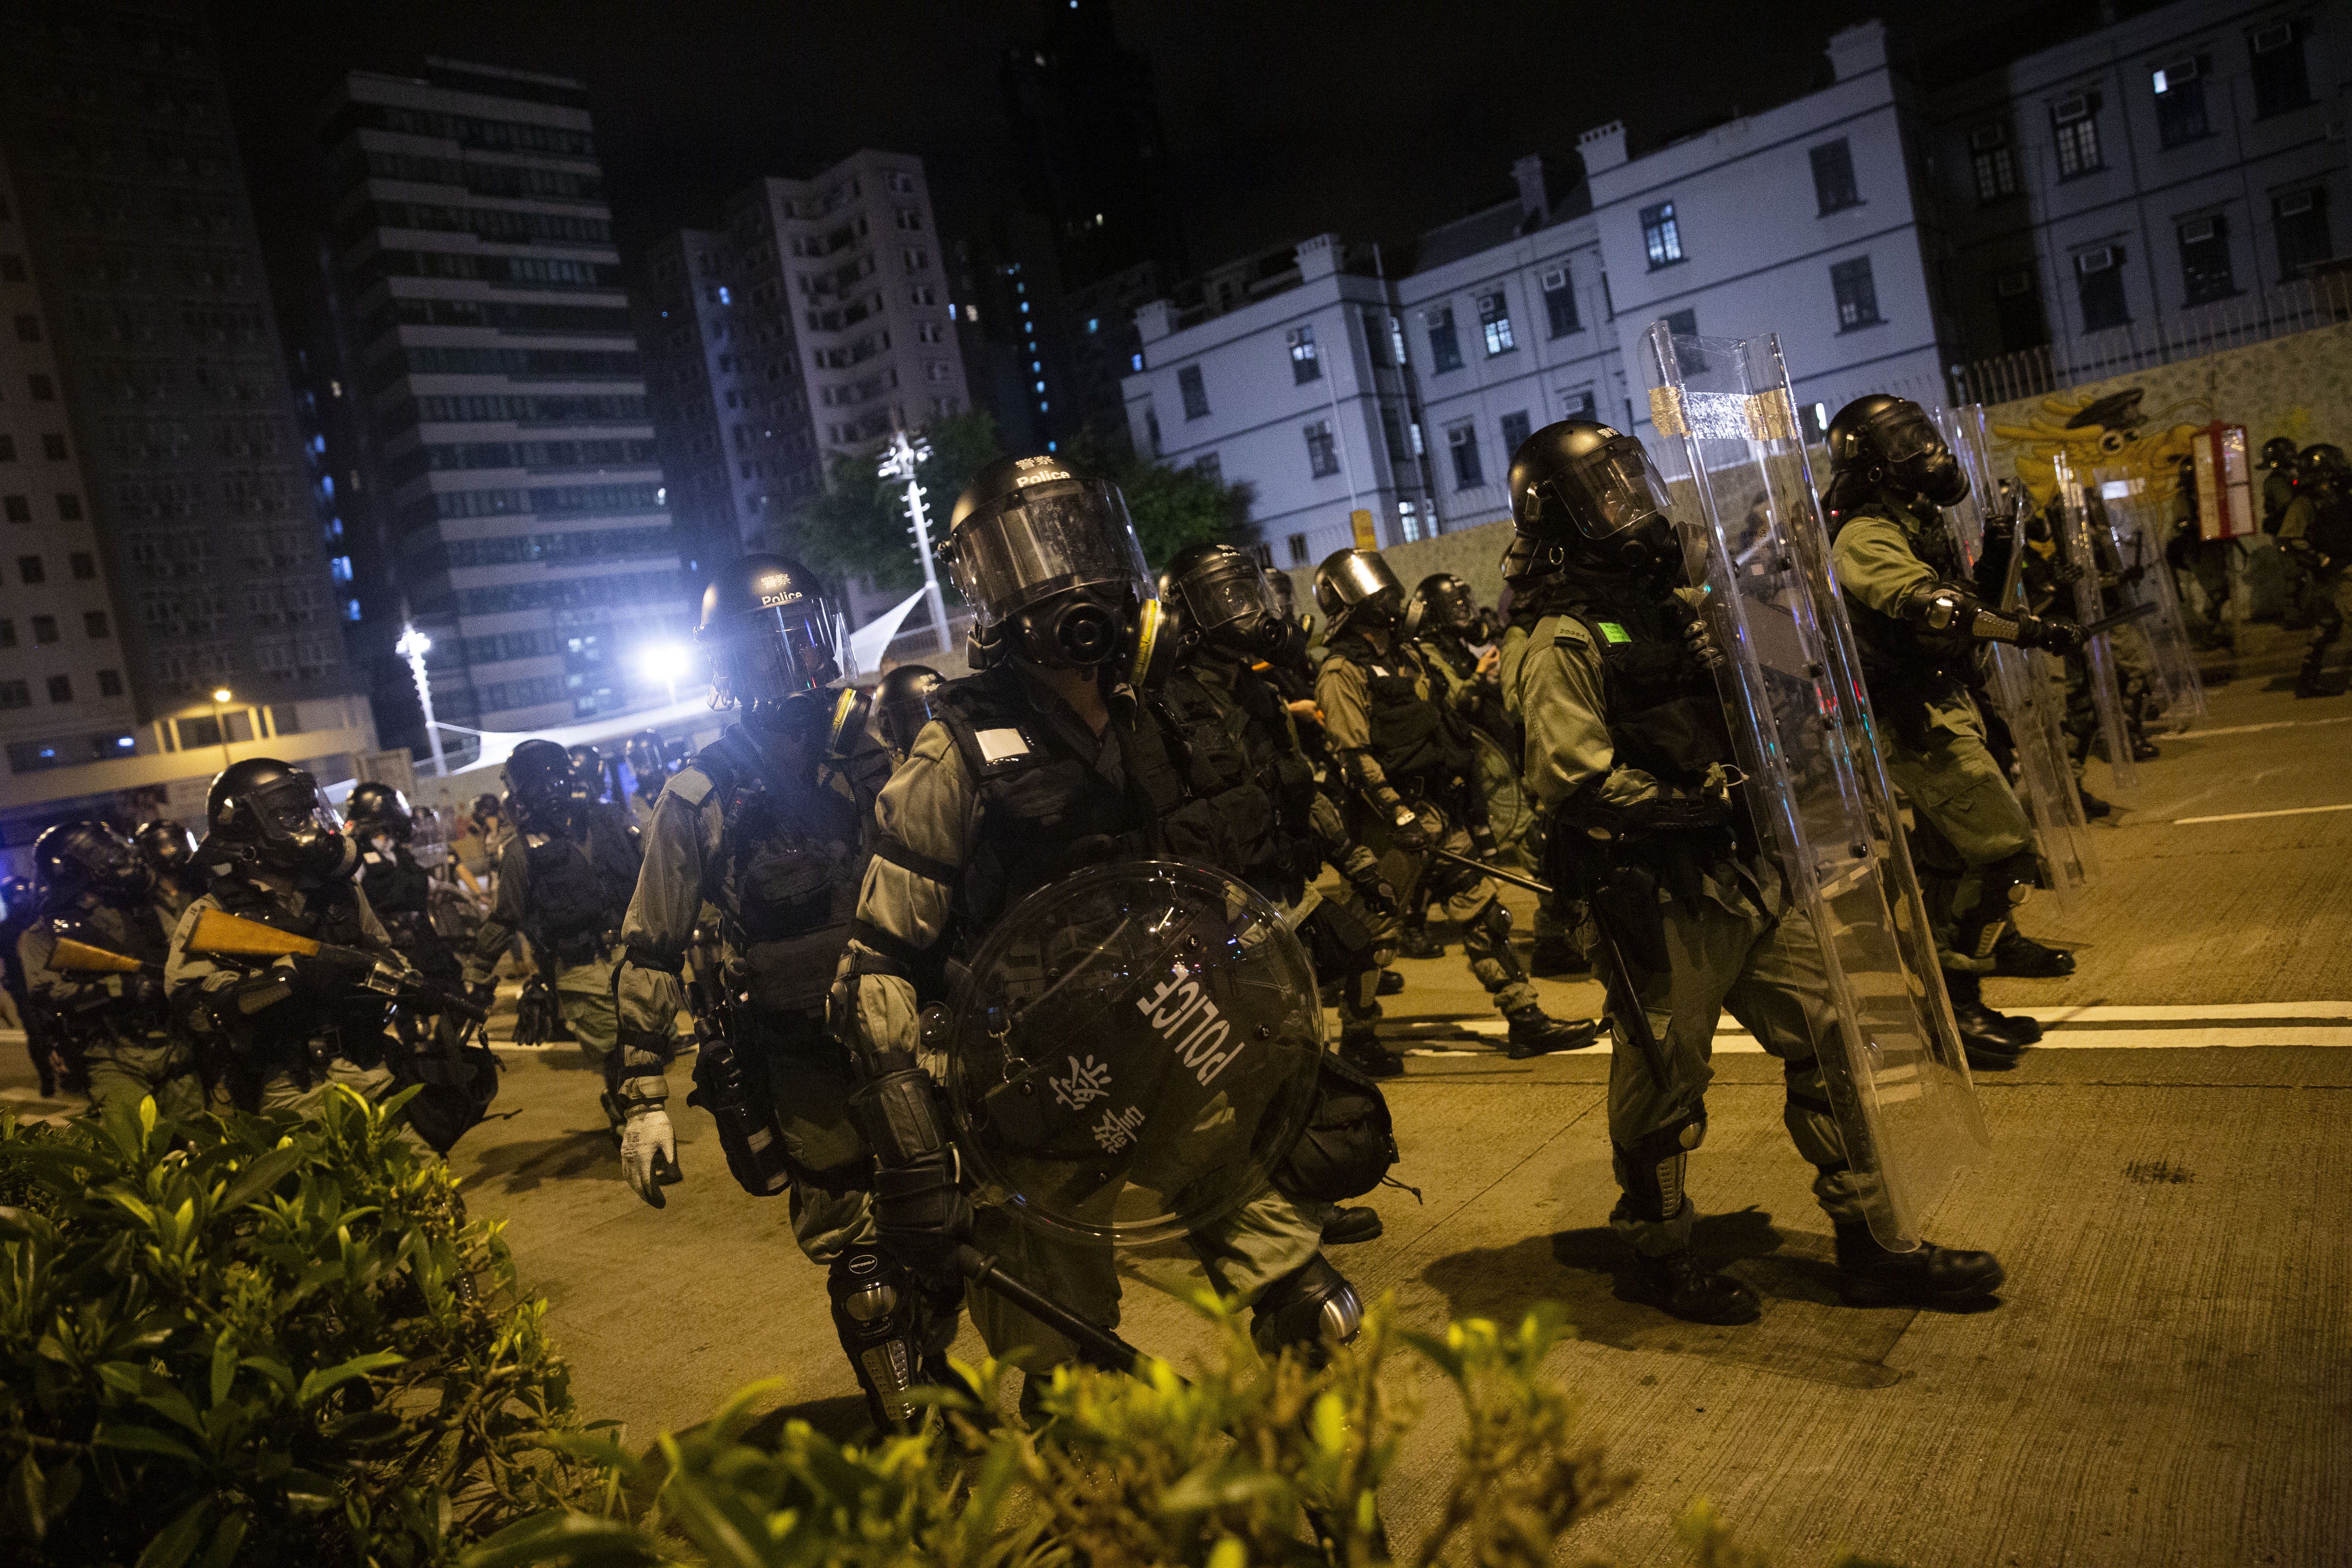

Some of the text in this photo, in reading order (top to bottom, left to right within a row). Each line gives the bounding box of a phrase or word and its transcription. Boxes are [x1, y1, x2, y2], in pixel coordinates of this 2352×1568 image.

[1015, 456, 1054, 470] 警察
[1016, 470, 1071, 488] Police
[760, 574, 791, 589] 警察
[762, 592, 803, 605] Police
[1136, 962, 1245, 1087] POLICE
[1049, 1054, 1145, 1154] 警察
[851, 1260, 875, 1268] MOTOWOLF
